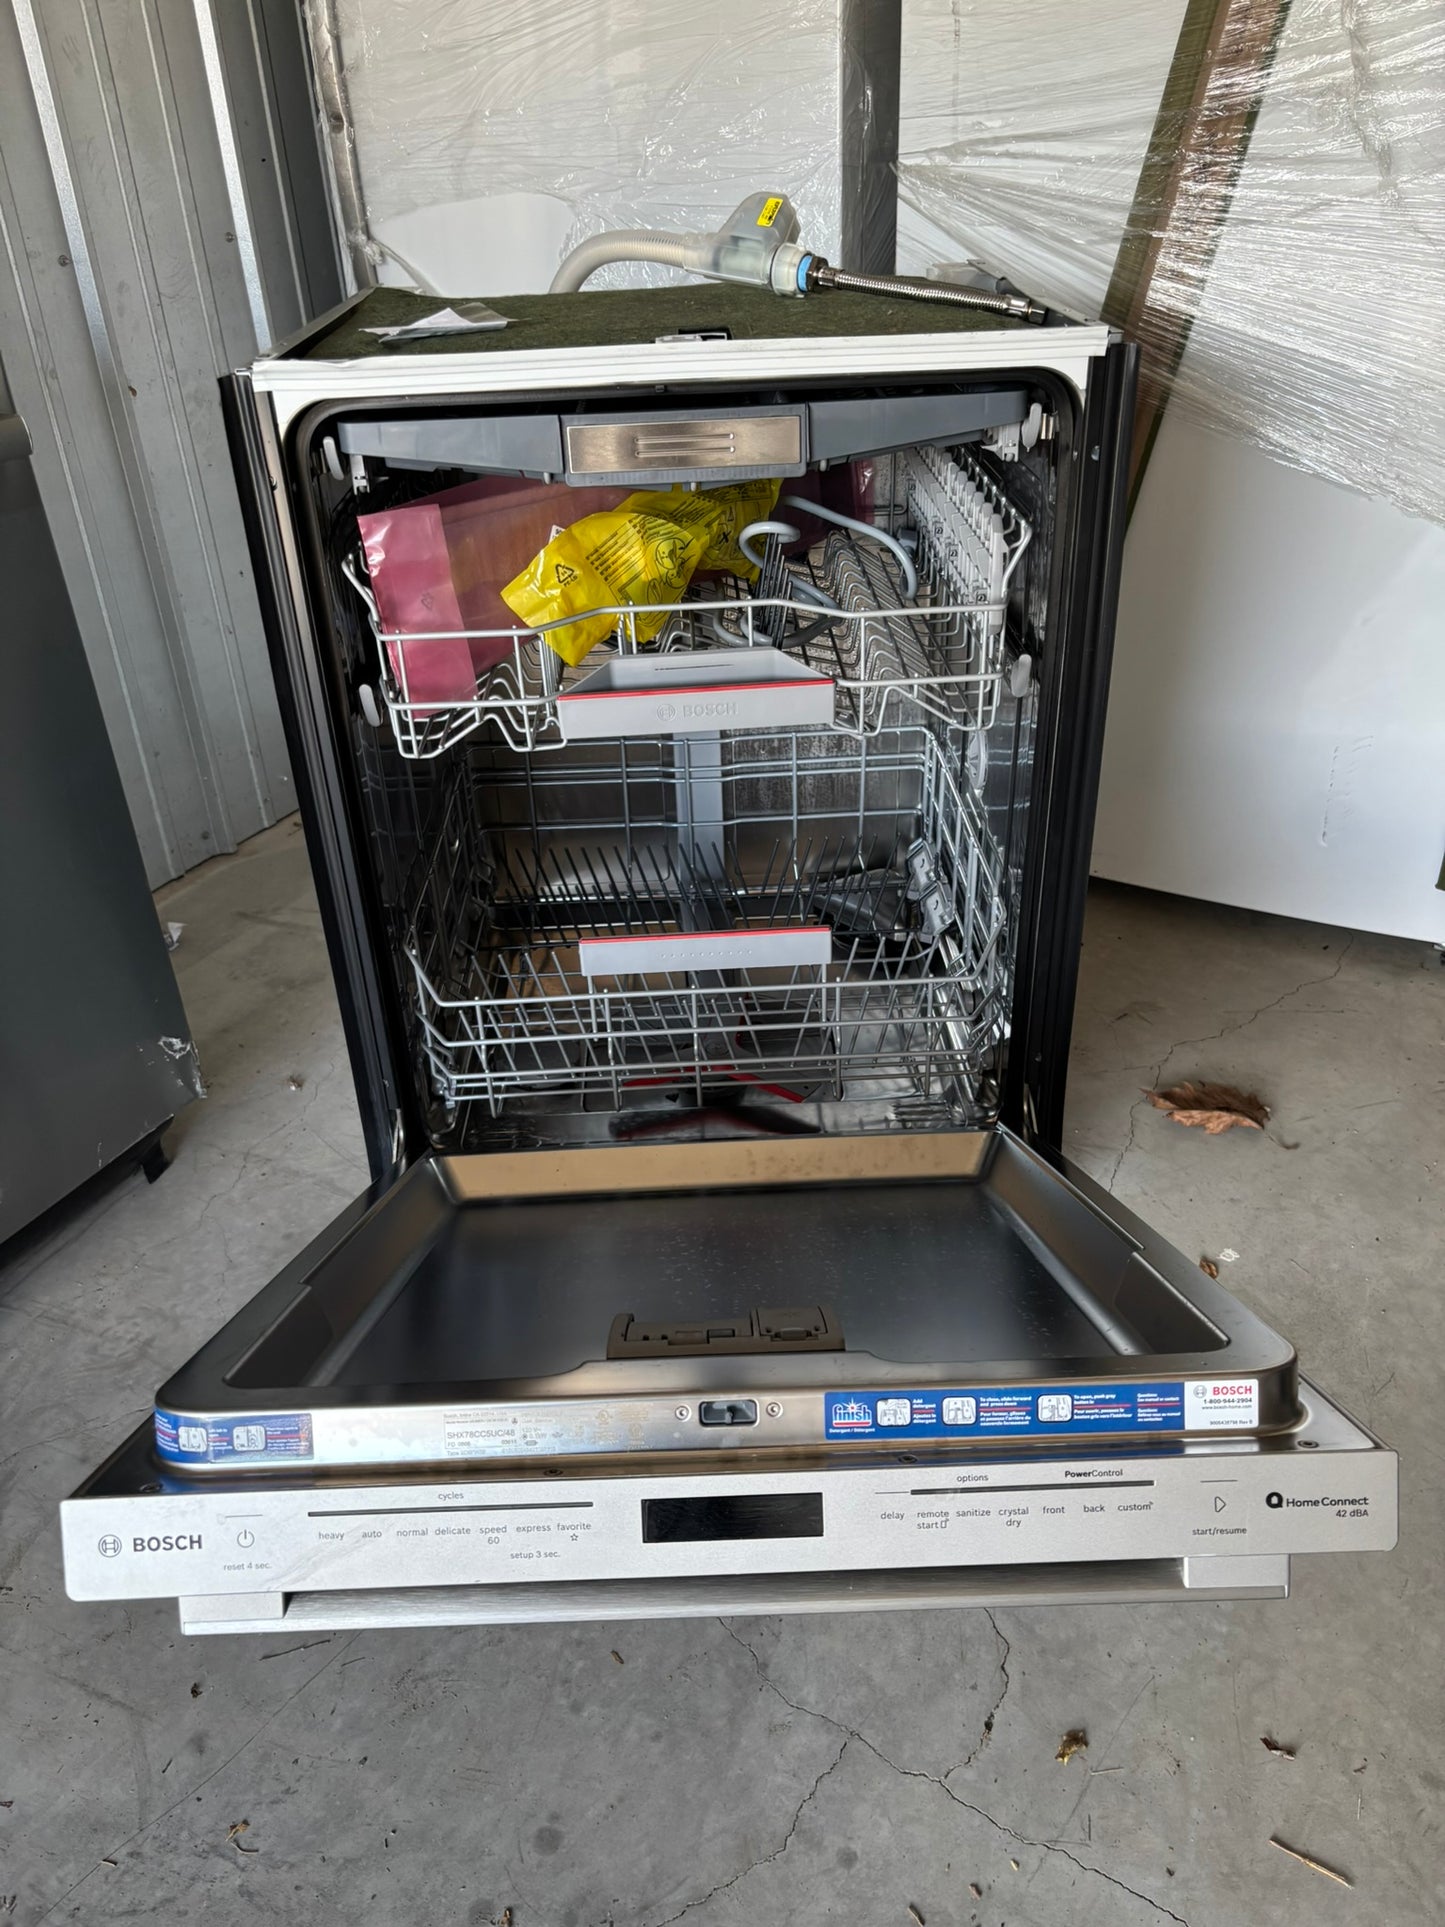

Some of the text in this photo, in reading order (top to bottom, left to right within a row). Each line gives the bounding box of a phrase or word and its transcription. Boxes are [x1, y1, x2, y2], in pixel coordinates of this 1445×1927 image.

[682, 702, 737, 716] BOSCH
[1213, 1385, 1252, 1396] BOSCH
[832, 1403, 872, 1421] finish
[956, 1474, 988, 1483] options
[1064, 1469, 1123, 1478] PowerControl
[438, 1491, 464, 1501] cycles
[1286, 1496, 1369, 1508] Home Connect
[880, 1503, 1151, 1522] delay remote sanitize crystal front back custom
[1349, 1509, 1369, 1517] dBA
[917, 1521, 939, 1529] start
[1006, 1518, 1021, 1528] dry
[318, 1522, 592, 1541] heavy auto normal delicate speed express favorite
[1192, 1527, 1247, 1536] start/resume
[132, 1534, 202, 1552] BOSCH
[487, 1536, 500, 1545] 60
[510, 1551, 534, 1560] setup
[247, 1562, 252, 1570] 4
